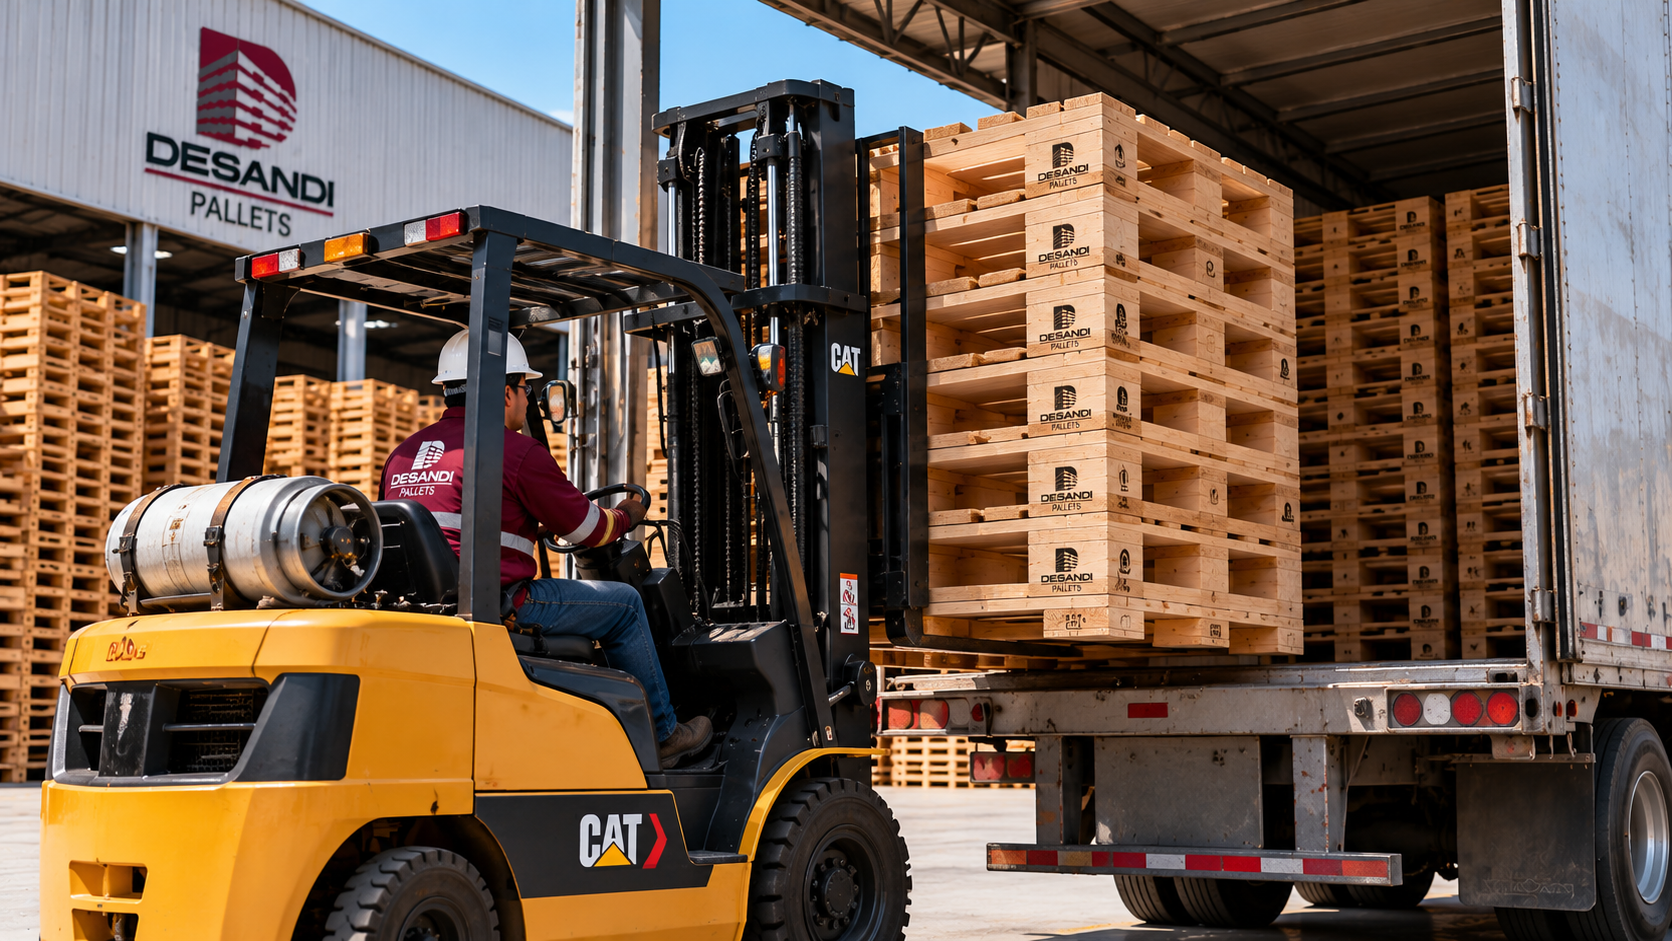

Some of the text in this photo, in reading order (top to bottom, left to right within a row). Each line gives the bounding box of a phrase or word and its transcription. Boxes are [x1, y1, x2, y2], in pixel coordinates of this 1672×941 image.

[145, 131, 335, 208] DESANDI
[1037, 163, 1089, 181] DESANDI
[190, 190, 292, 238] PALLETS
[1038, 245, 1090, 263] DESANDI
[1039, 327, 1091, 342] DESANDI
[830, 342, 861, 377] CAT
[1040, 408, 1092, 422] DESANDI
[390, 470, 455, 486] DESANDI
[398, 486, 436, 498] PALLETS
[1040, 490, 1093, 502] DESANDI
[579, 813, 643, 868] CAT
